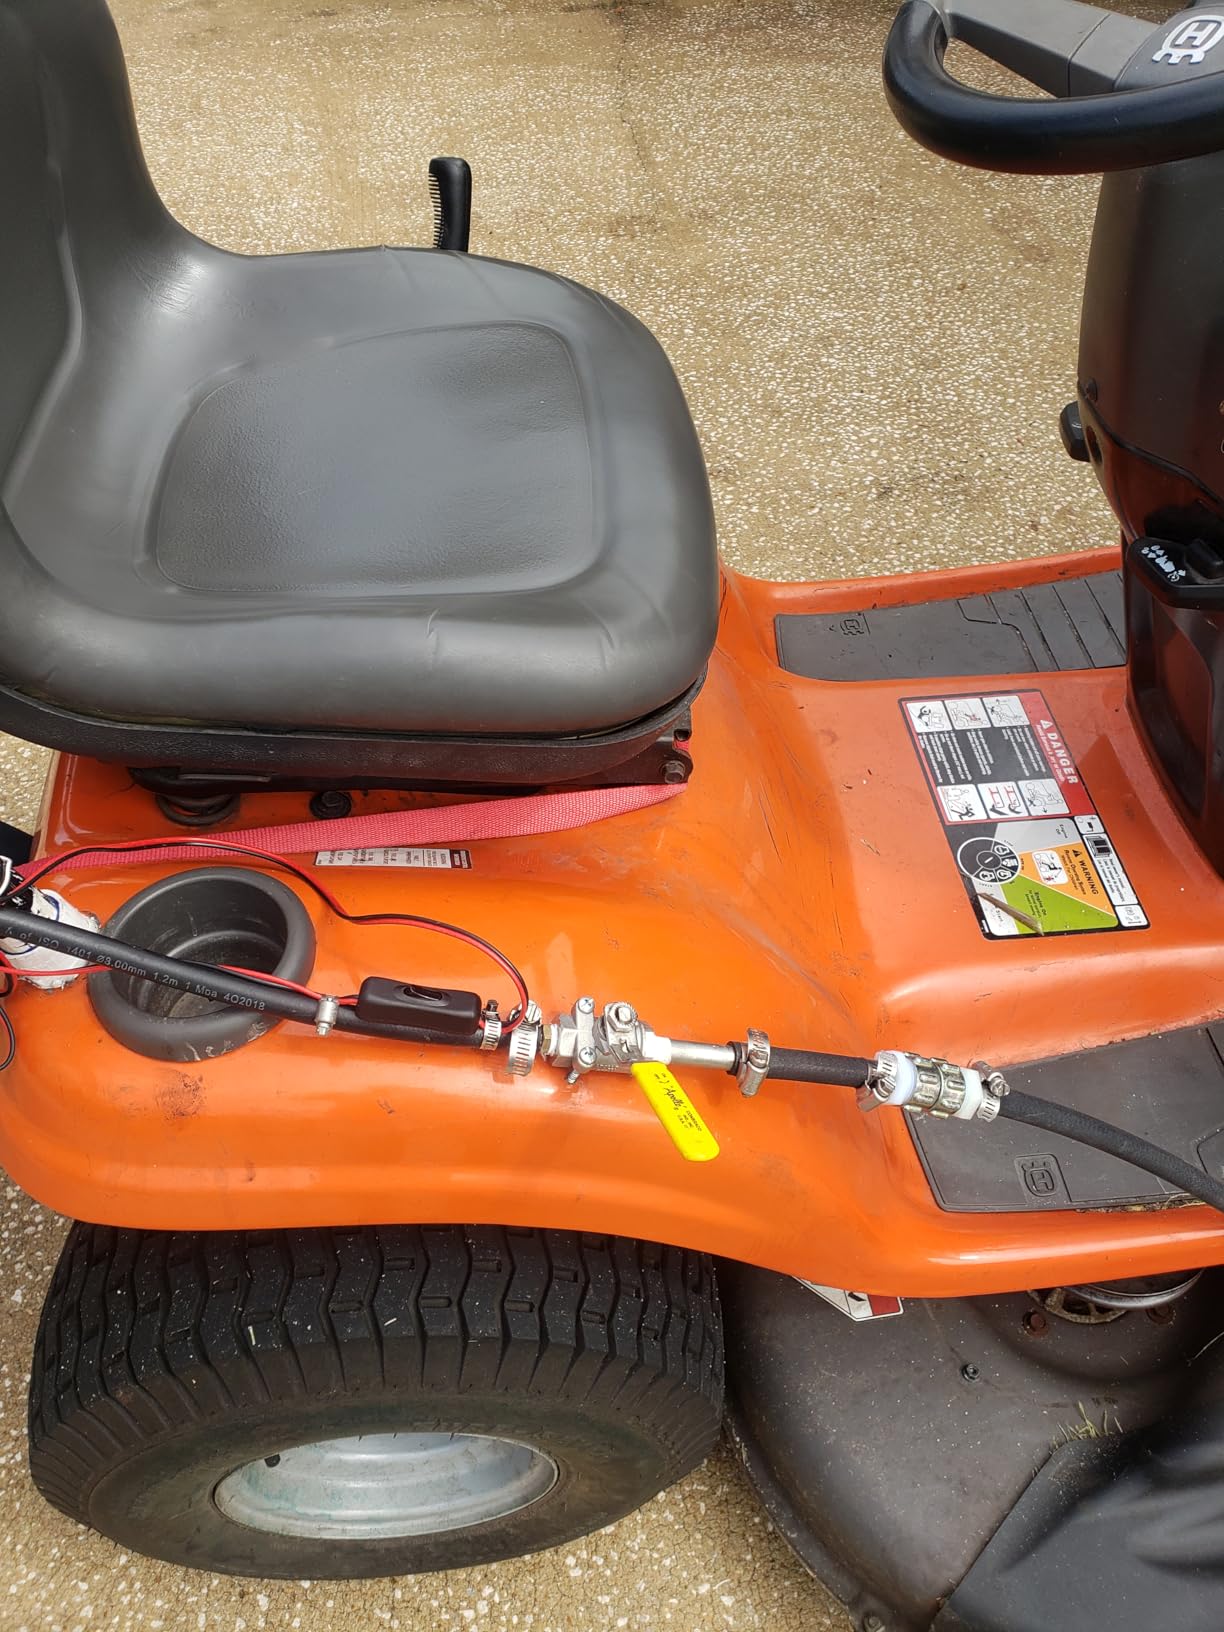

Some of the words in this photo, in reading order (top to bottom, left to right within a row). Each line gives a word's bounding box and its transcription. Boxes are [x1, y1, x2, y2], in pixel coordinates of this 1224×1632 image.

[1046, 732, 1079, 783] DANGER
[1077, 860, 1099, 894] WARNING
[1032, 891, 1044, 907] Engine
[39, 937, 60, 949] ISO
[153, 972, 179, 987] 1.2m
